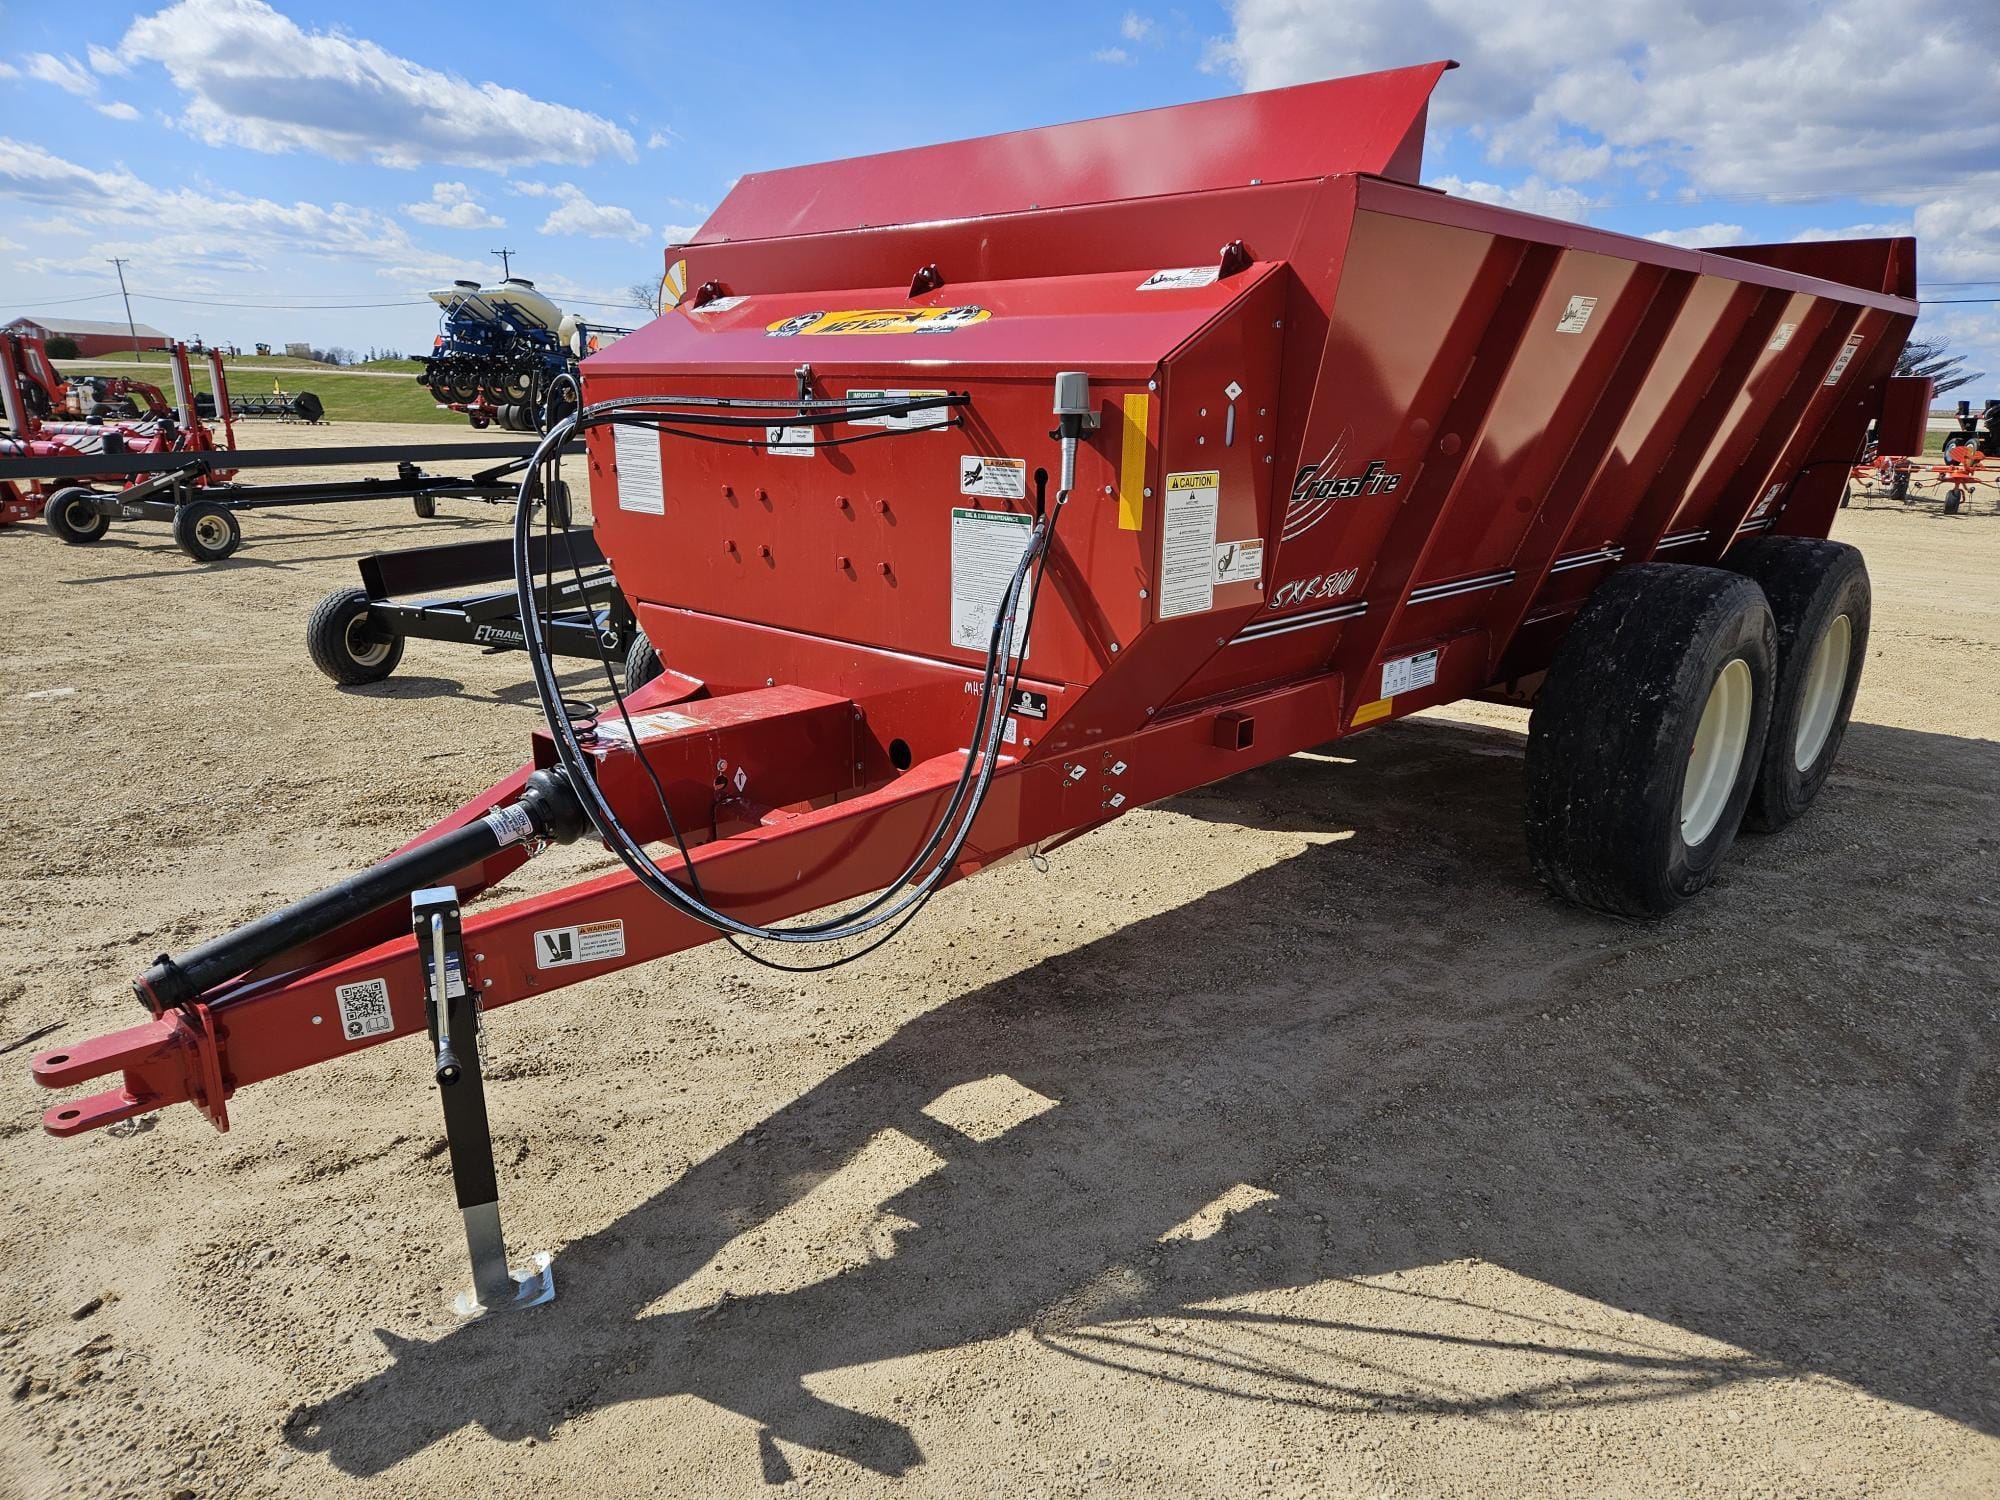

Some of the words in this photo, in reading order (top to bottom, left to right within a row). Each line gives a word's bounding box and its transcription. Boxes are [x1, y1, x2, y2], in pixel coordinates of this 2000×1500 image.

[1179, 476, 1212, 488] CAUTION
[1290, 460, 1402, 502] CrossFire
[1268, 575, 1322, 610] SXR
[1316, 567, 1359, 598] 500
[586, 923, 620, 932] WARNING
